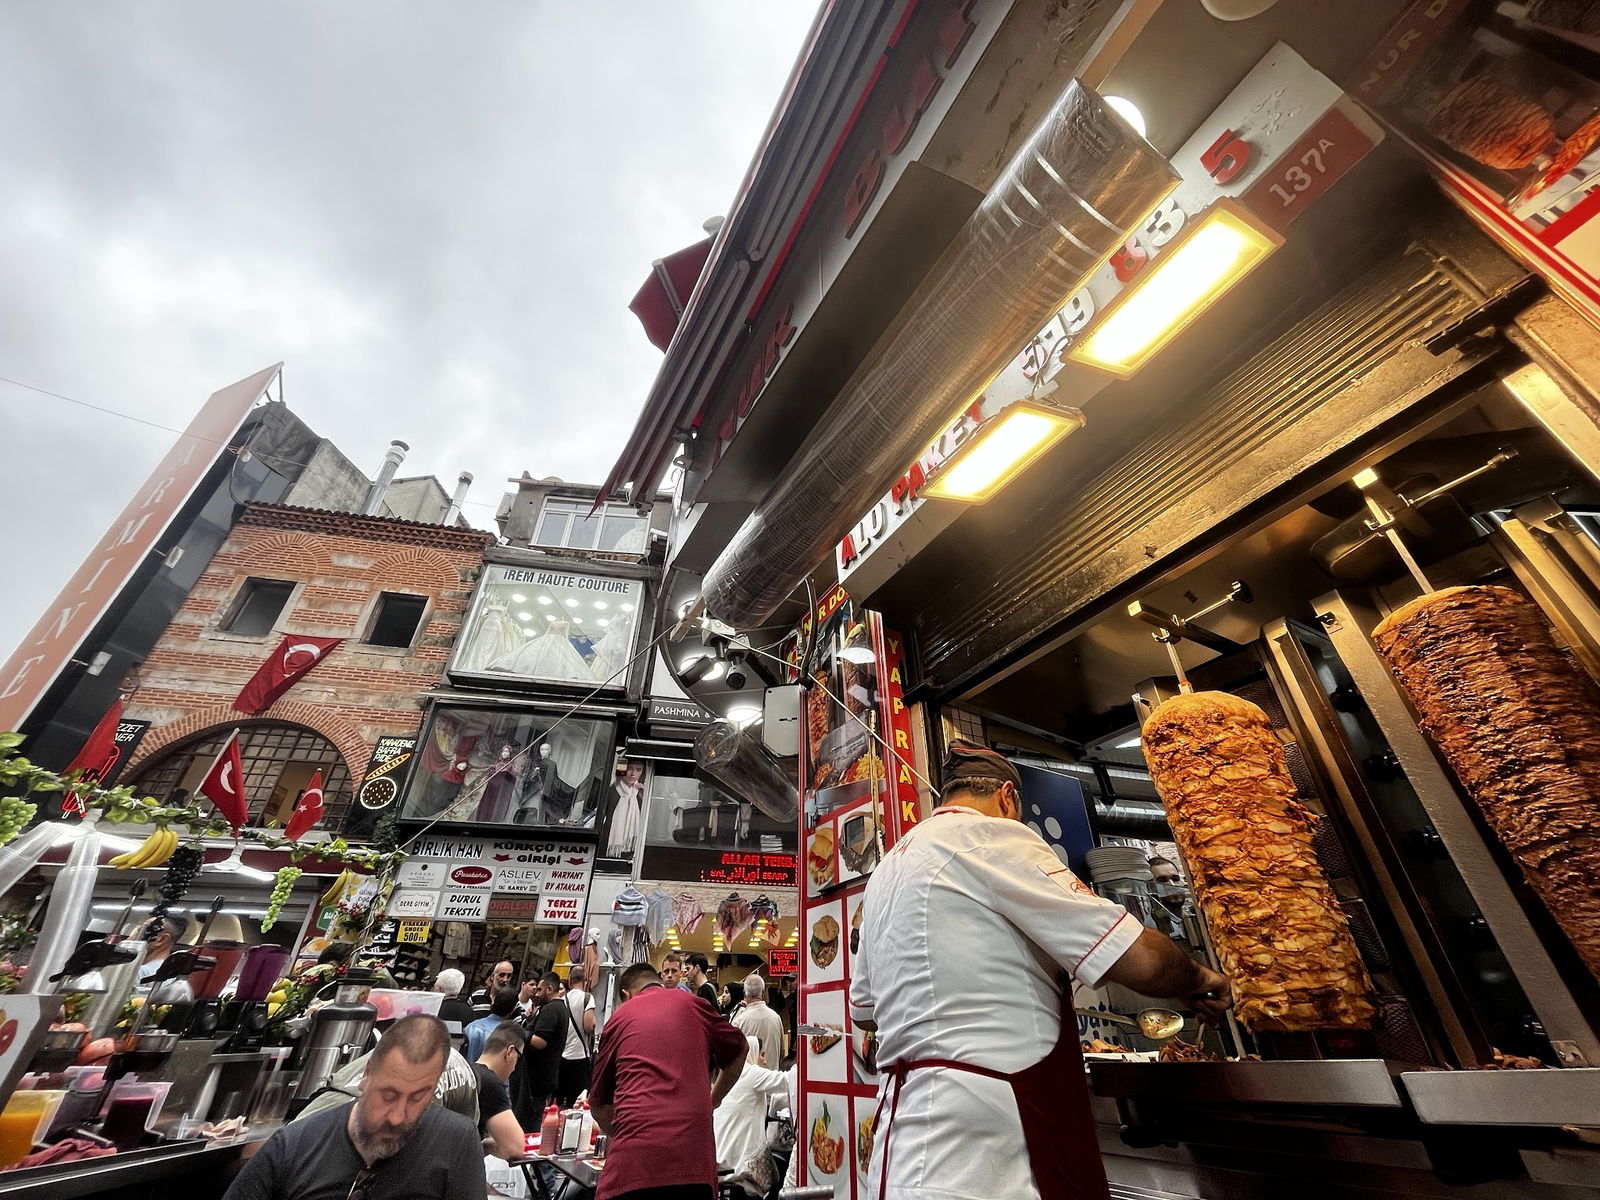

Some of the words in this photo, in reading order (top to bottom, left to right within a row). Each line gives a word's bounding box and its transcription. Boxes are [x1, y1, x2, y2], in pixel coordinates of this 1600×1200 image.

[840, 502, 889, 570] ALO
[889, 393, 986, 515] PAKET
[1108, 197, 1187, 283] 83
[537, 573, 575, 587] HAUTE
[578, 578, 630, 594] COUTURE
[829, 586, 849, 611] DÖ
[654, 706, 701, 718] PASHMINA
[117, 723, 144, 733] ZZET
[886, 637, 918, 824] YAPRAK
[115, 733, 135, 742] NER
[411, 837, 455, 857] BİRLİK
[456, 843, 484, 859] HAN
[559, 845, 589, 854] HAN
[551, 870, 585, 880] WARYANT
[544, 882, 555, 891] BY
[555, 883, 585, 893] ATAKLAR
[450, 895, 481, 904] DURUL
[547, 898, 577, 908] TERZİ
[444, 906, 481, 917] TEKSTİL
[543, 909, 577, 919] YAVUZ
[403, 932, 419, 942] 500
